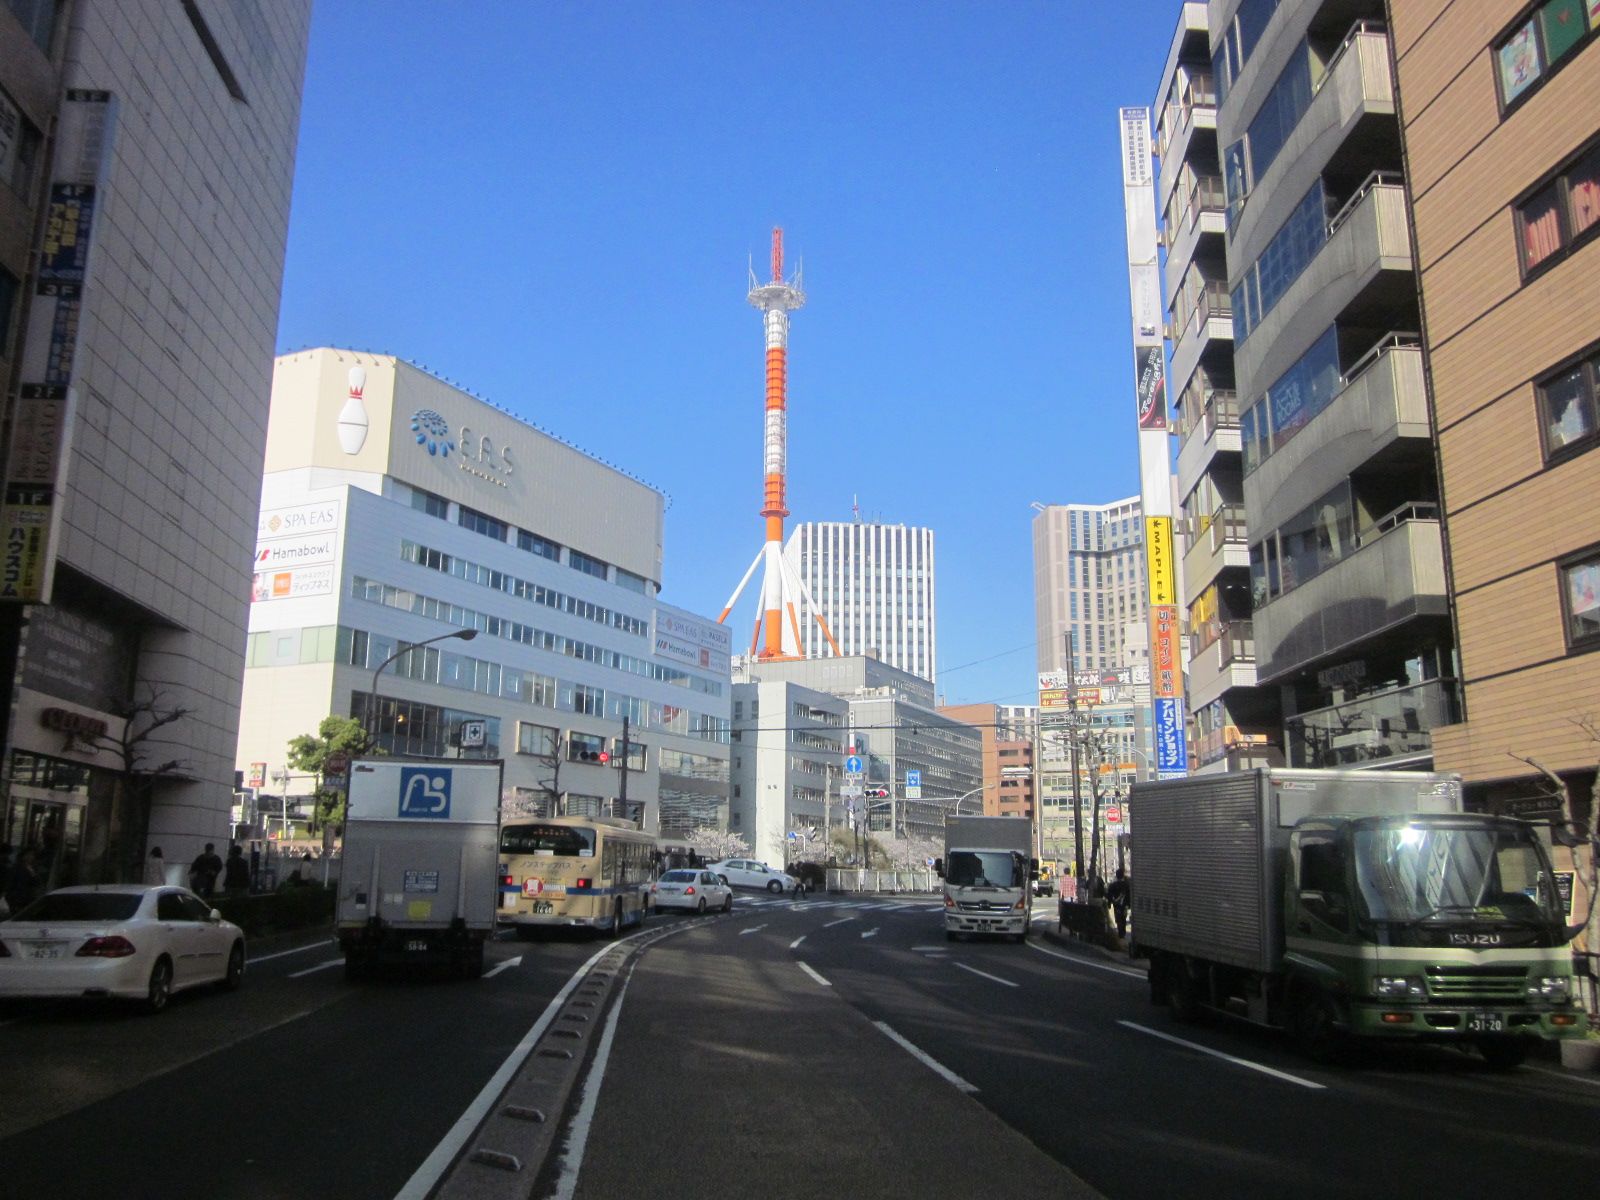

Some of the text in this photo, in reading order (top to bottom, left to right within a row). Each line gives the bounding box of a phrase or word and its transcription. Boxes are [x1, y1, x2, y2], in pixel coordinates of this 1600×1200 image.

[44, 284, 75, 296] 3F
[34, 385, 57, 399] 2F
[18, 492, 45, 505] 1F
[284, 508, 334, 529] SPA EAS
[272, 541, 330, 560] Hamabowl
[1154, 531, 1163, 590] MAPLE
[1, 527, 26, 597] ハウスコム
[1160, 637, 1170, 666] コイン
[1162, 699, 1178, 767] アパマンショップ
[1449, 933, 1501, 945] ISUZU
